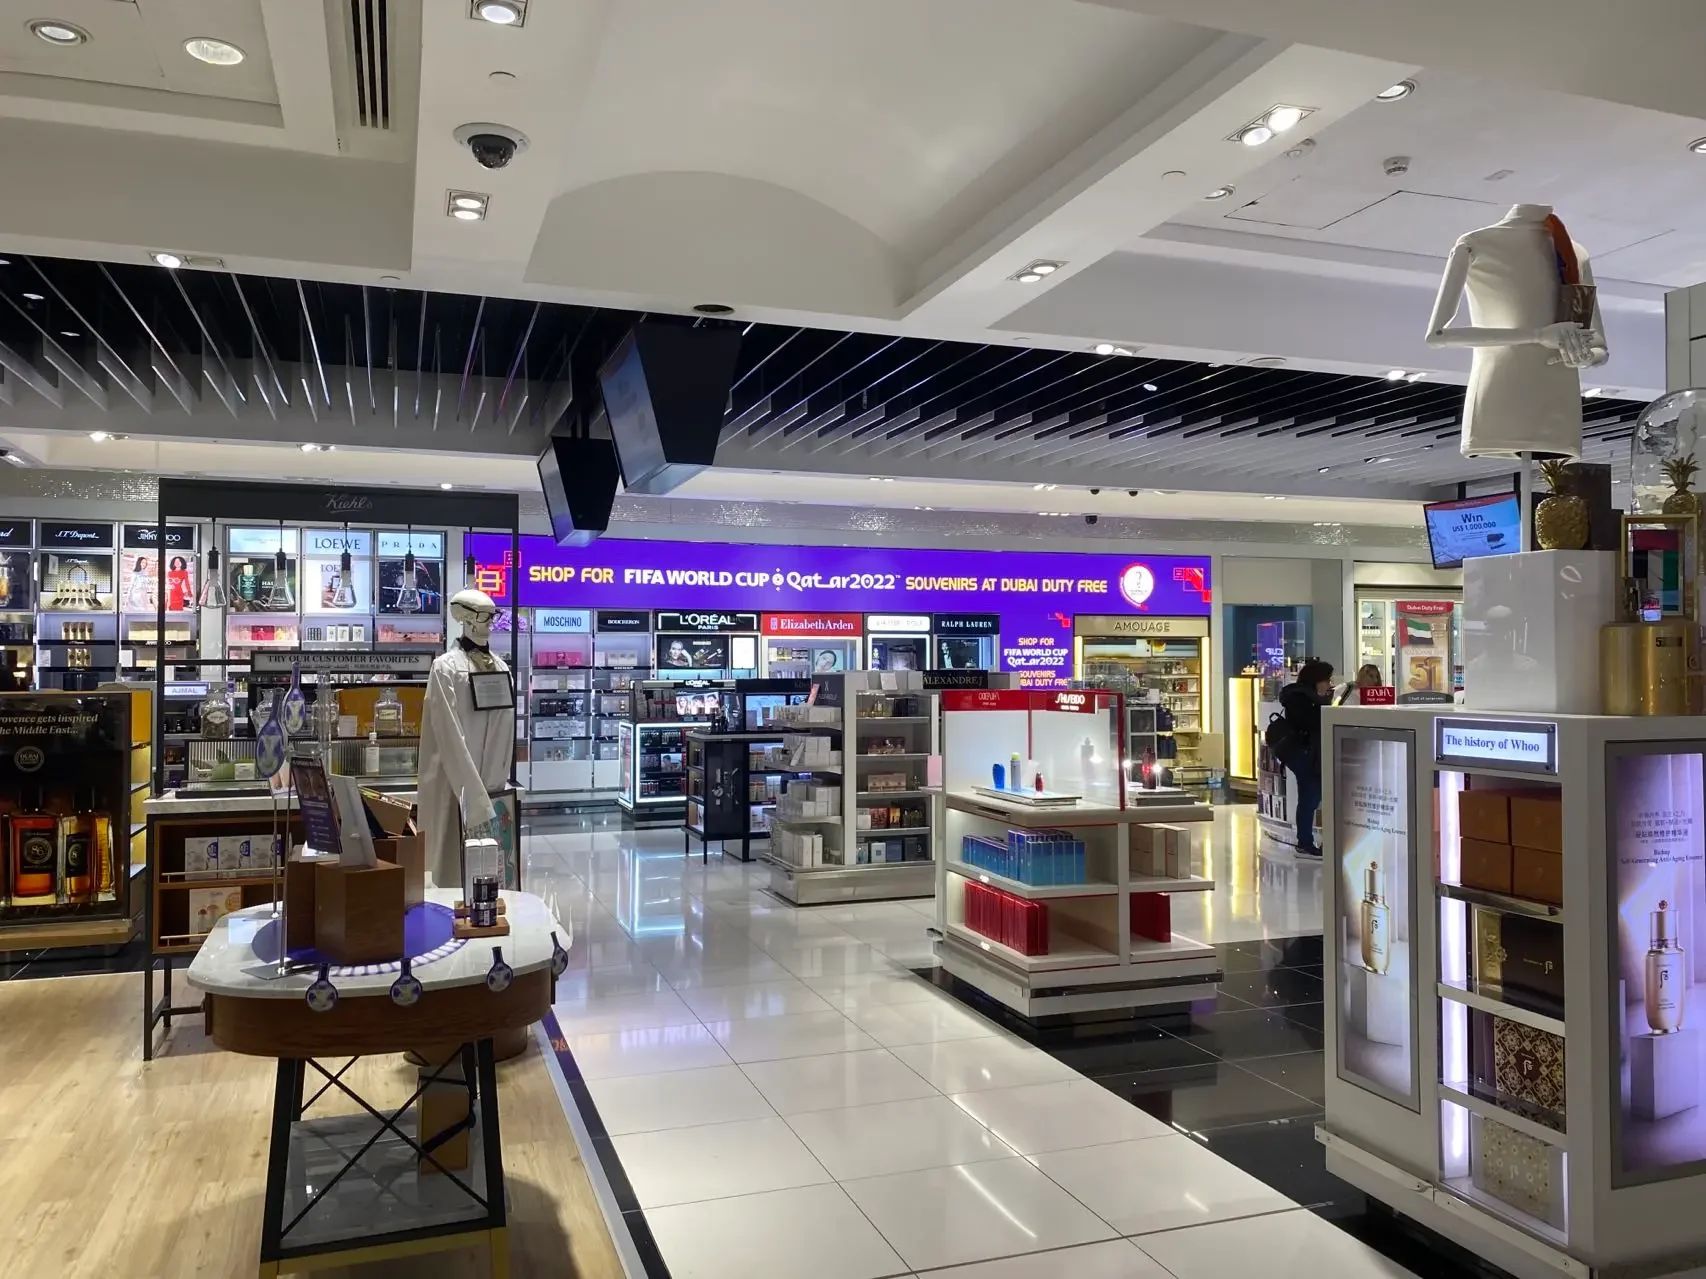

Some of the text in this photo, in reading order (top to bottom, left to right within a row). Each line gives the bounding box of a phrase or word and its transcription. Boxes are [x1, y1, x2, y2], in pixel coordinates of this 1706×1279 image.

[1461, 513, 1483, 523] Win
[314, 537, 361, 550] LOEWE
[529, 566, 575, 583] SHOP
[581, 567, 614, 584] FOR
[624, 568, 665, 585] FIFA
[666, 570, 733, 586] WORLD
[735, 571, 770, 587] CUP
[905, 576, 978, 591] SOUVENIRS
[981, 577, 997, 591] AT
[1001, 578, 1037, 593] DUBAI
[1042, 578, 1074, 593] DUTY
[1077, 579, 1108, 593] FREE
[543, 616, 582, 627] MOSCHINO
[941, 620, 992, 628] RALPH LAUREN
[1114, 622, 1171, 632] AMOUAGE
[1018, 638, 1054, 646] SHOP FOR
[1004, 648, 1068, 657] FIFA WORLD CUP
[268, 655, 288, 663] TRY
[312, 655, 365, 663] CUSTOMER
[369, 655, 420, 664] FAVORITES
[1020, 678, 1033, 686] BAI
[1035, 678, 1053, 686] DUTY
[36, 715, 56, 724] gets
[58, 713, 99, 724] inspired
[13, 726, 48, 735] Middle
[1445, 734, 1540, 752] The history of Whoo
